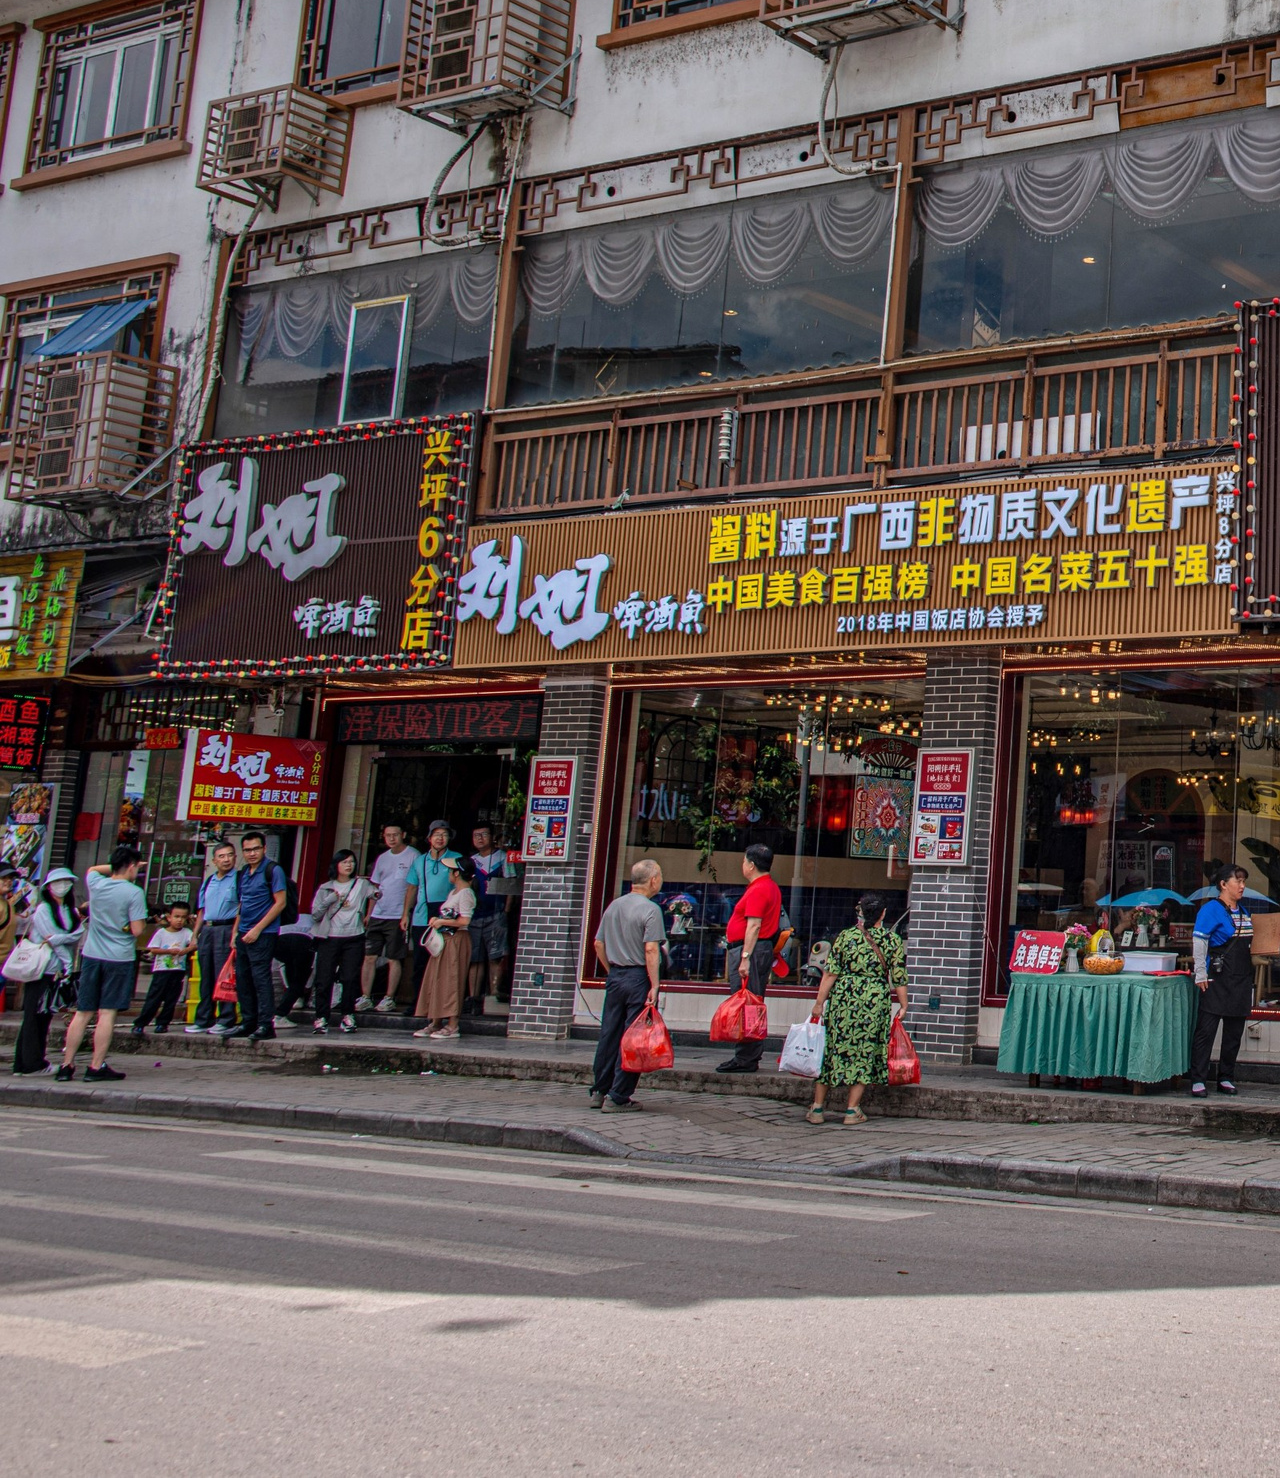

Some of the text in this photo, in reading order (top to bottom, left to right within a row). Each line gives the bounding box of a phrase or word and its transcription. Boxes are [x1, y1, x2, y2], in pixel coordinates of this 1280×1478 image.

[400, 430, 453, 651] 兴坪6分店
[708, 474, 1212, 565] 酱料源于广西非物质文化遗产
[1213, 471, 1234, 585] 兴坪8分店
[706, 543, 1210, 614] 中国美食百强榜 中国名菜五十强
[293, 595, 383, 638] 啤酒鱼
[613, 590, 707, 641] 啤酒鱼
[837, 604, 1045, 635] 2018年中国饭店协会授予
[309, 751, 322, 786] 6分店
[193, 783, 318, 806] 酱料源于广西非物质文化遗产
[193, 803, 314, 821] 中国美食百强榜 中国名菜五十强
[1013, 943, 1062, 970] 免费停车
